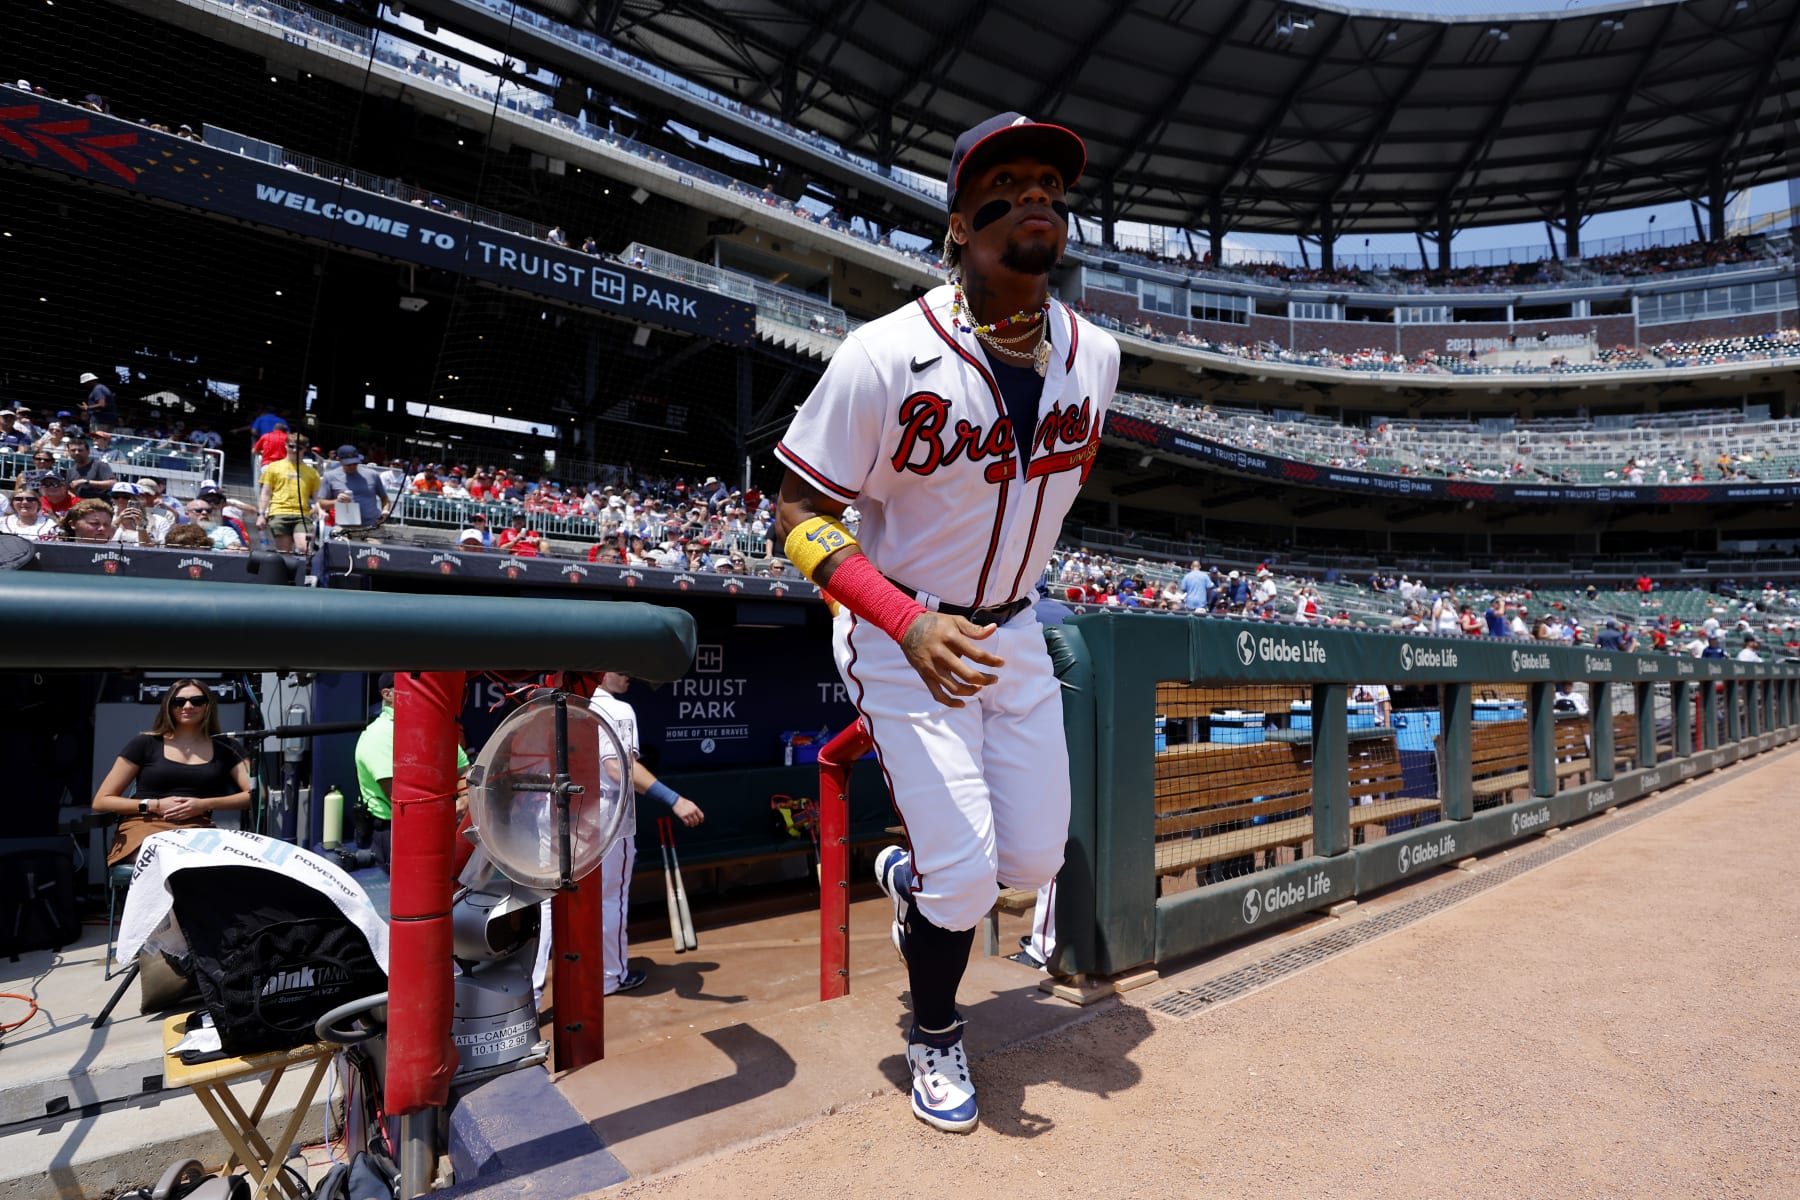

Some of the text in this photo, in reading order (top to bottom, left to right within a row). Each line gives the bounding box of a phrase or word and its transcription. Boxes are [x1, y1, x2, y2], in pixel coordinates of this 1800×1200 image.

[256, 183, 454, 250] WELCOME TO
[478, 240, 698, 318] TRUIST PARK
[1516, 334, 1585, 349] CHAPIONS
[891, 390, 1091, 476] Braves
[1215, 448, 1238, 462] TRUIST
[1247, 457, 1267, 469] PARK
[1373, 478, 1398, 489] TRUIST
[1411, 482, 1433, 491] PARK
[1564, 490, 1596, 498] TRUIST
[1611, 490, 1637, 498] PARK
[816, 530, 845, 553] 13
[92, 552, 108, 564] JIM
[356, 548, 371, 559] JIM
[430, 554, 444, 564] JIM
[178, 558, 192, 569] JIM
[498, 559, 511, 570] JIM
[1259, 637, 1327, 664] Globe Life
[1415, 648, 1458, 668] Globe Life
[1521, 653, 1550, 669] Globe Life
[672, 679, 747, 696] TRUIST
[679, 701, 736, 719] PARK
[666, 729, 688, 738] HOME
[691, 729, 701, 737] OF
[721, 727, 749, 736] BRAVES
[1520, 806, 1550, 830] Globe Life
[1412, 834, 1456, 866] Globe Life
[294, 854, 359, 899] POWERADE
[1265, 872, 1331, 913] Globe Life
[475, 1035, 526, 1055] 10.113.2.96
